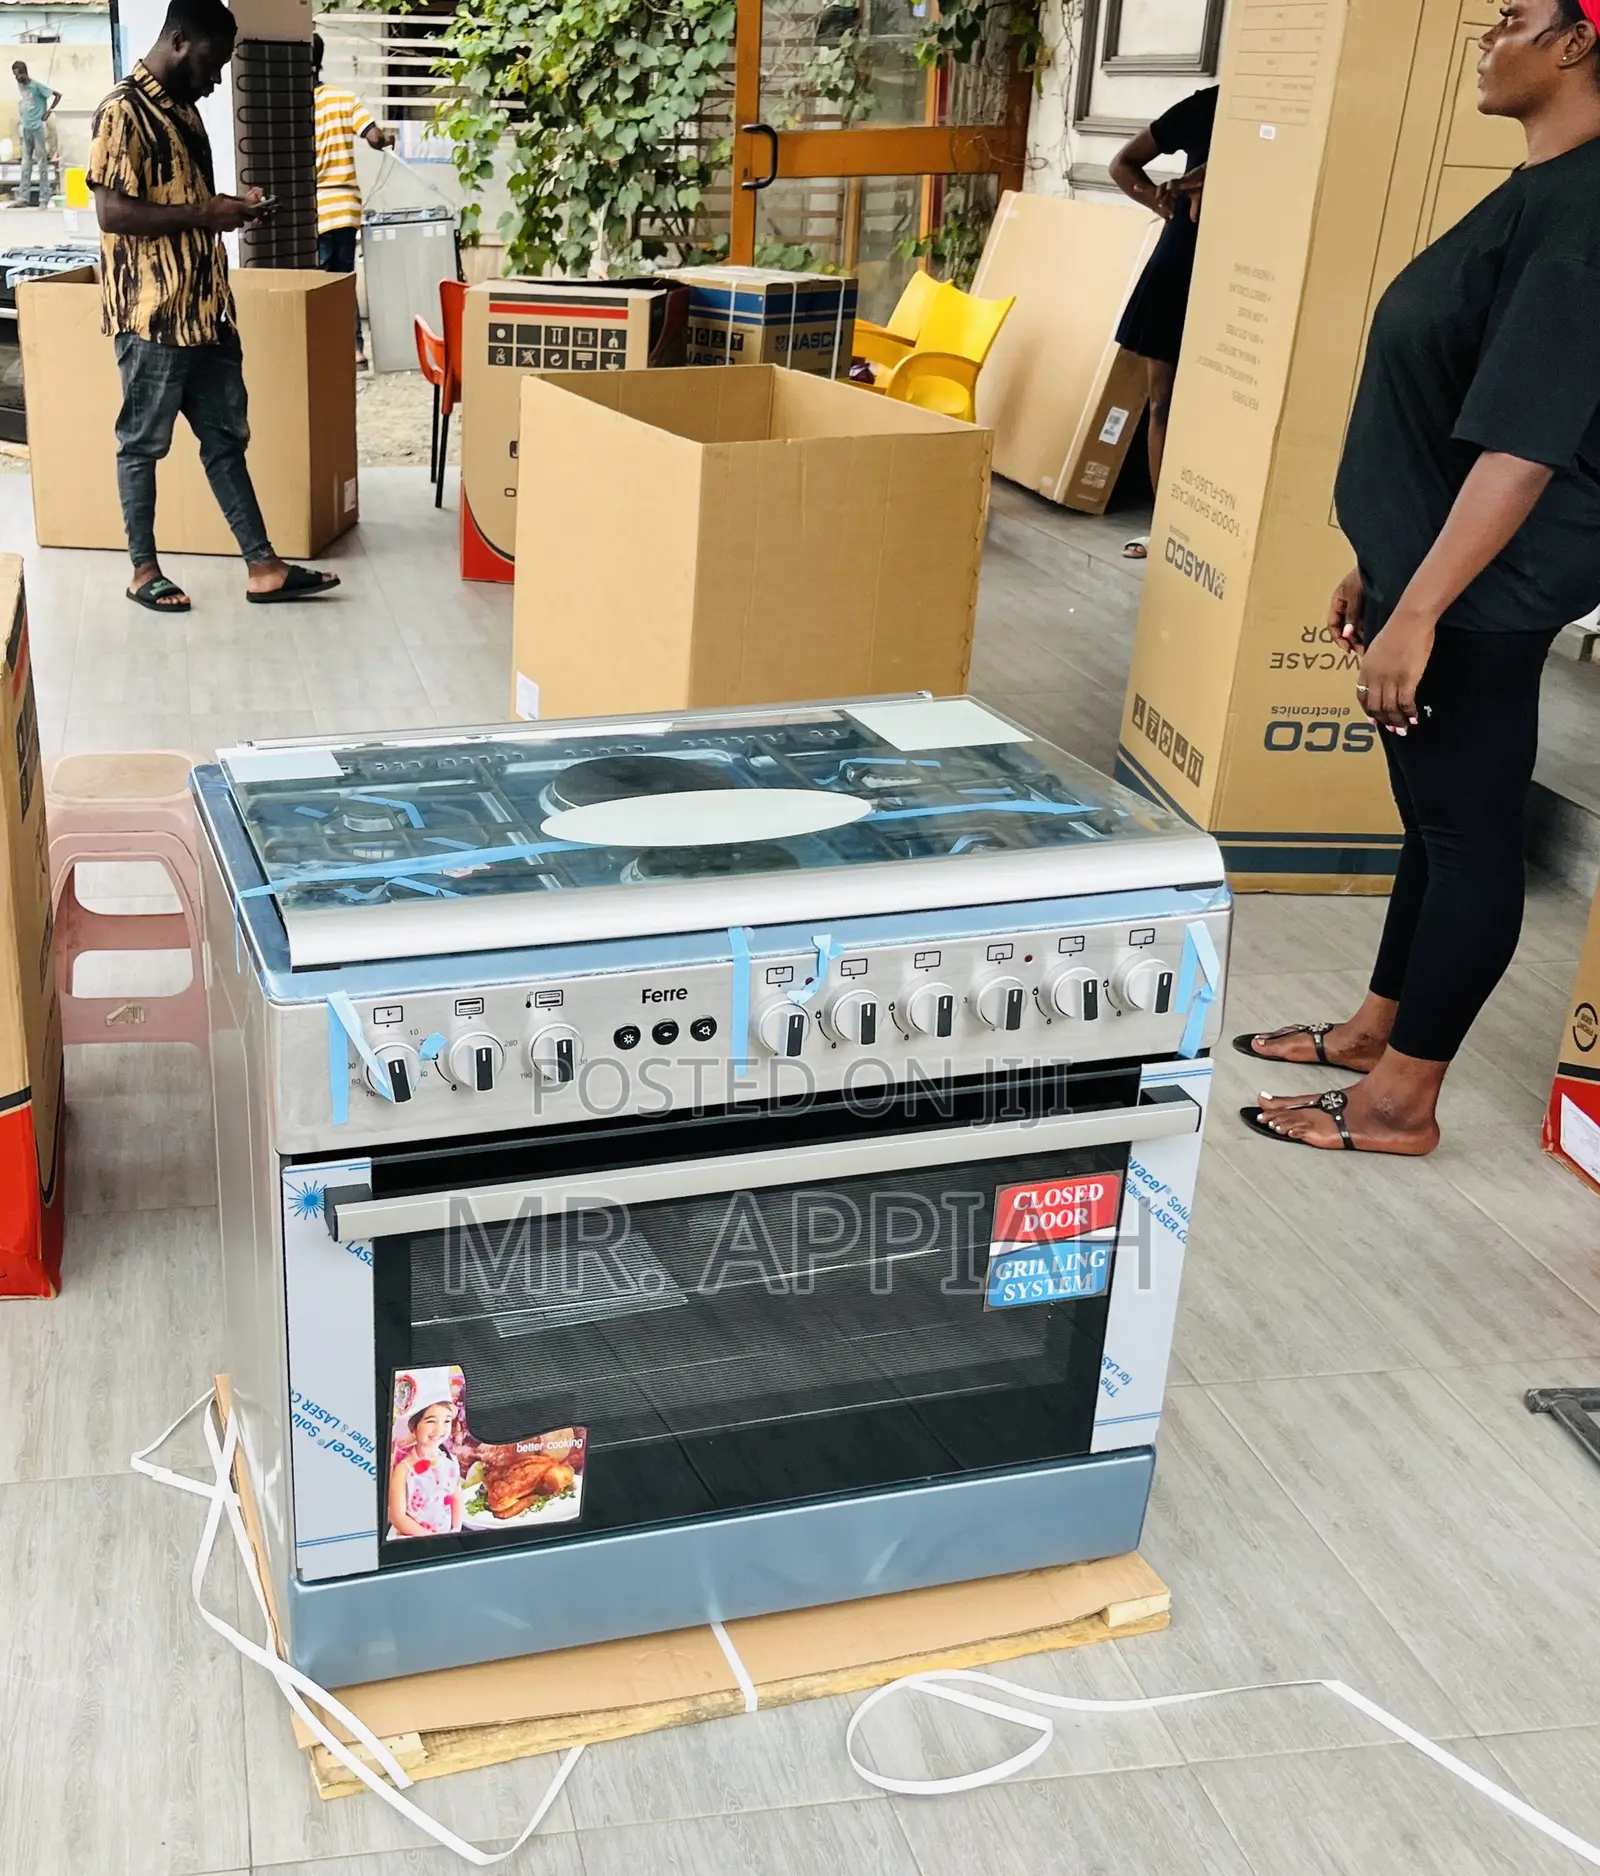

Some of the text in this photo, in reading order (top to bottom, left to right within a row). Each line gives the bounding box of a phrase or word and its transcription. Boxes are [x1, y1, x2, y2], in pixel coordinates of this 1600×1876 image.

[1170, 483, 1211, 519] SHOWCASE
[1165, 537, 1216, 594] NASCO
[1270, 652, 1360, 670] WCASE
[1271, 705, 1350, 718] electronics
[1264, 721, 1376, 752] SCO
[642, 987, 688, 1004] Ferre
[1013, 1183, 1104, 1211] CLOSED
[1167, 1196, 1190, 1223] Solu
[1023, 1208, 1088, 1232] DOOR
[1149, 1204, 1179, 1232] LASER
[995, 1249, 1106, 1280] GRILLING
[1003, 1273, 1092, 1301] SYSTEM
[1102, 1354, 1132, 1386] for LAS
[1100, 1377, 1119, 1398] The
[291, 1413, 320, 1437] Solu
[301, 1399, 340, 1429] LASER
[346, 1430, 376, 1454] Fiber
[516, 1438, 583, 1453] better cooking
